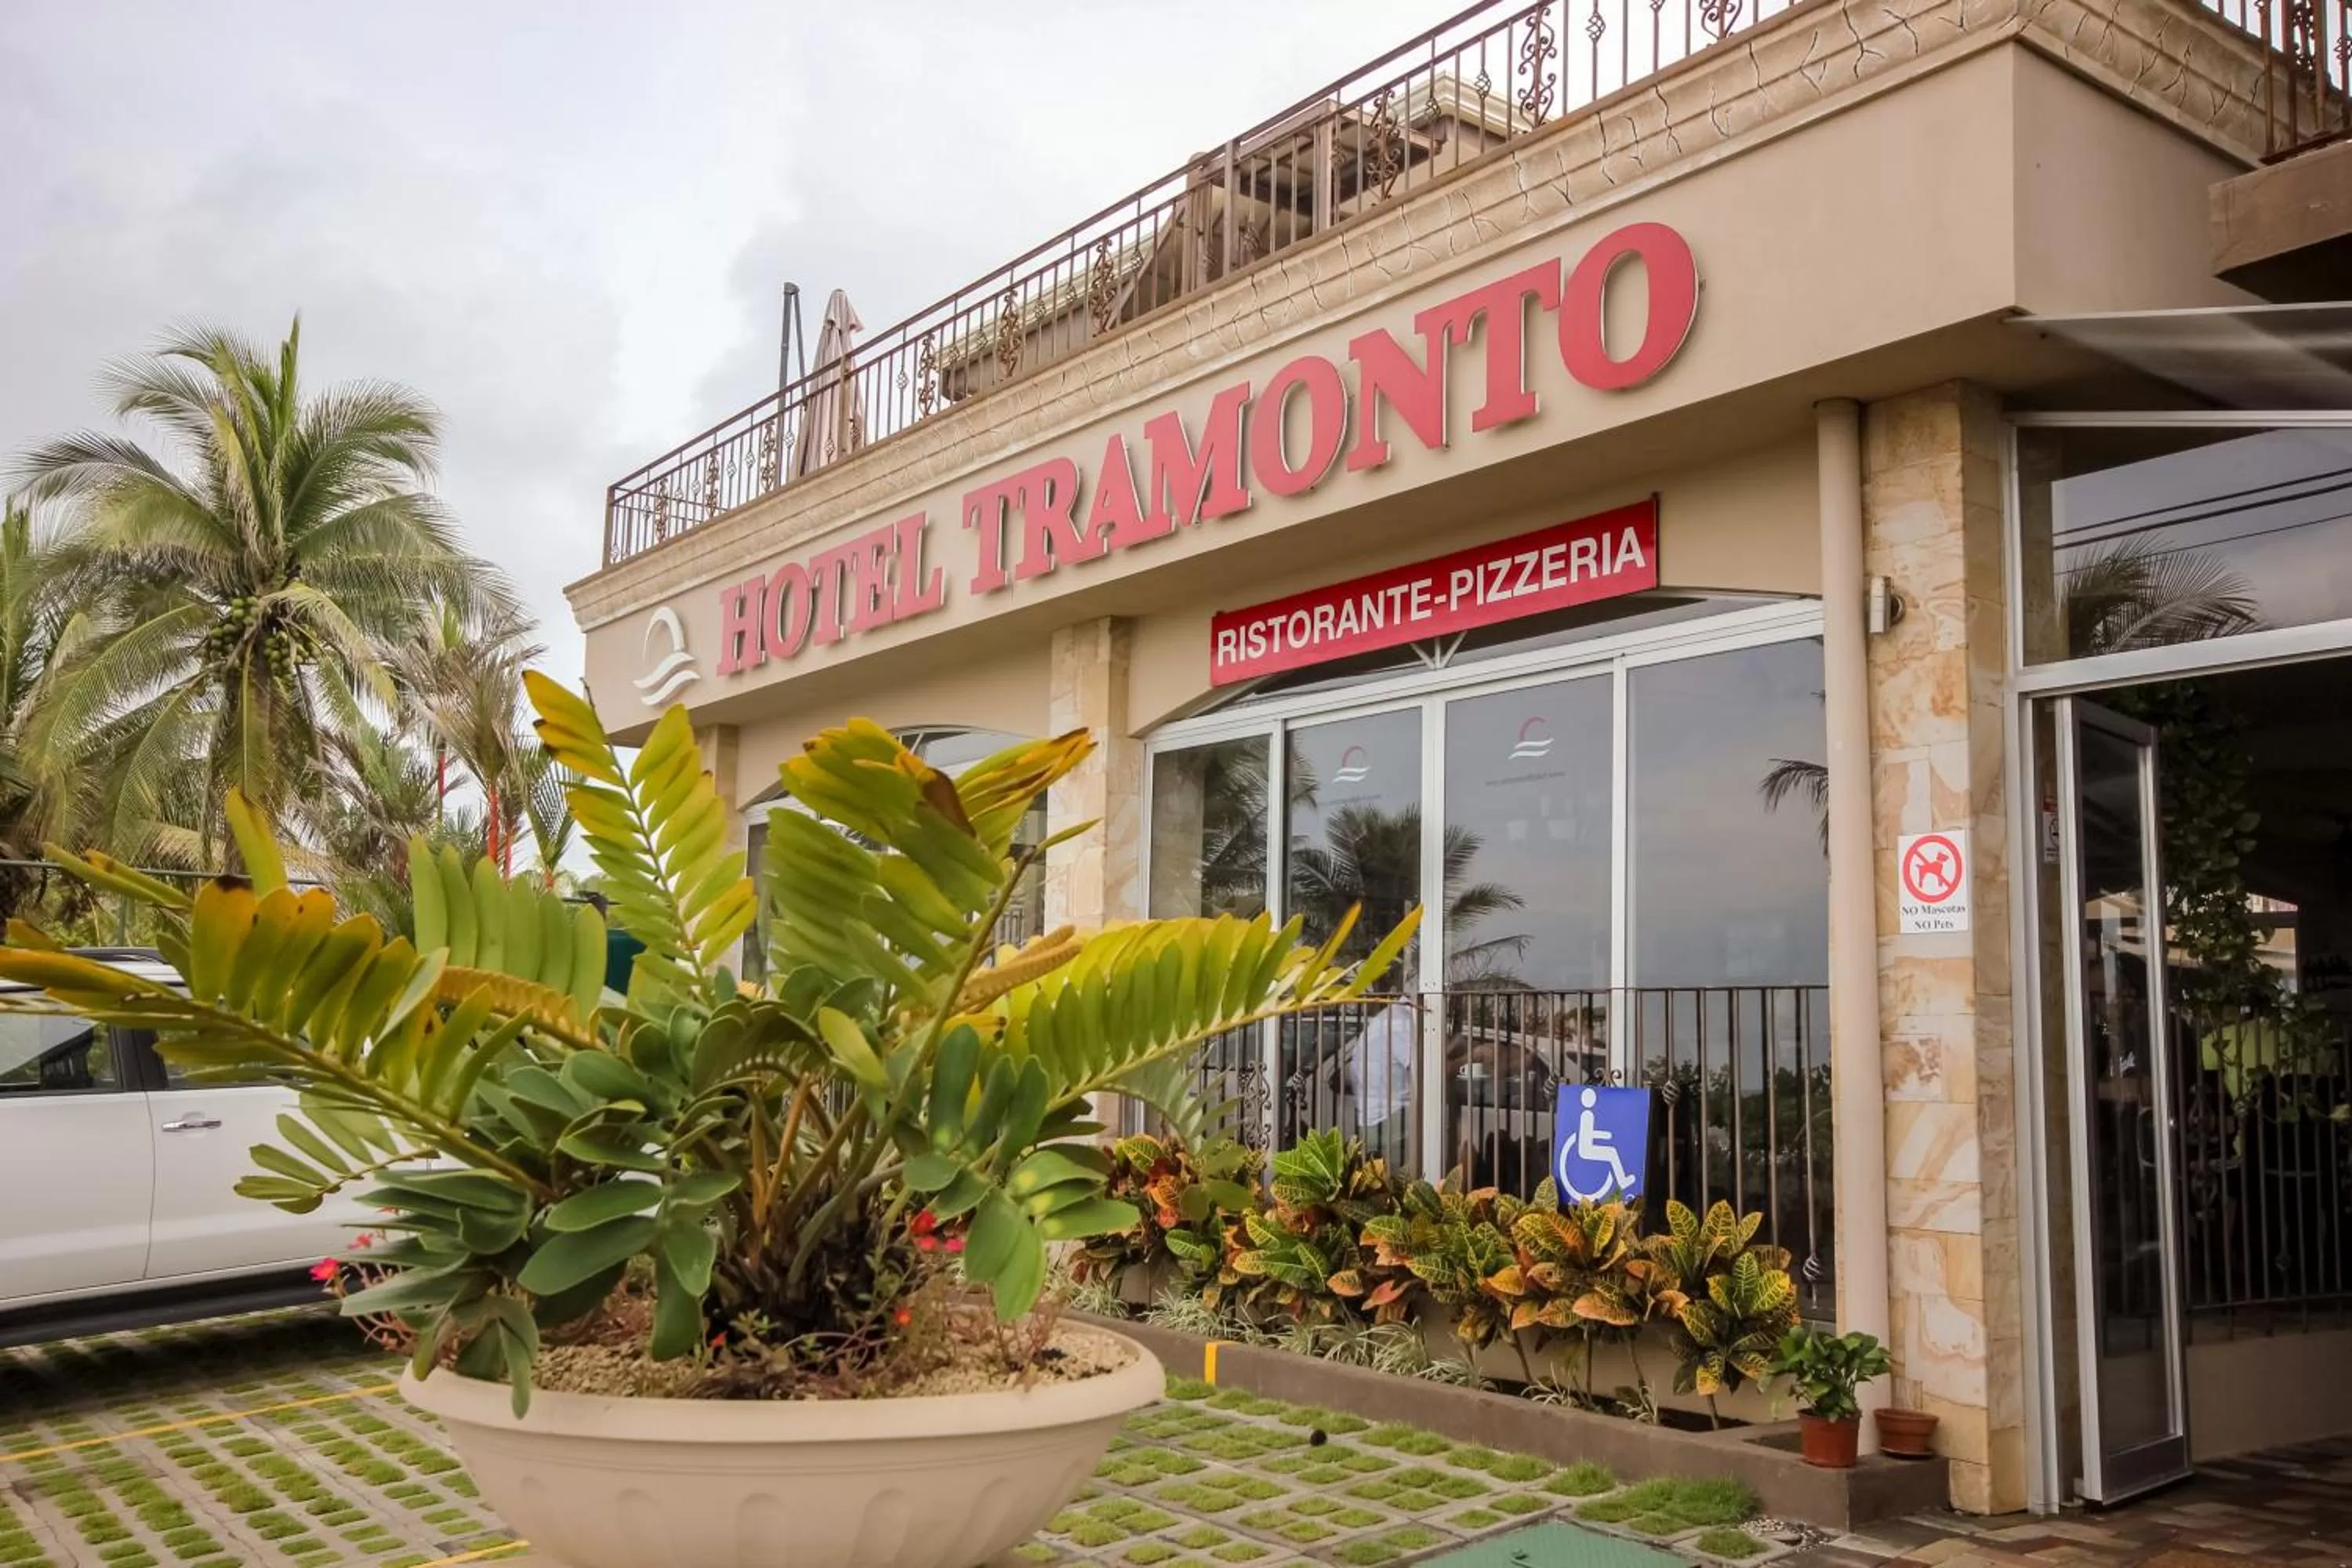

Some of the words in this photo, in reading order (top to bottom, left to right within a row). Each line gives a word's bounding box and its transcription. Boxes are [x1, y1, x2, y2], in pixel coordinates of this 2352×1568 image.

[716, 510, 945, 677] HOTEL
[962, 222, 1700, 595] TRAMONTO
[1216, 526, 1646, 666] RISTORANTE-PIZZERIA
[1902, 906, 1918, 916] NO
[1922, 905, 1966, 915] Mascotas
[1915, 921, 1931, 930] NO
[1934, 920, 1955, 930] Pets
